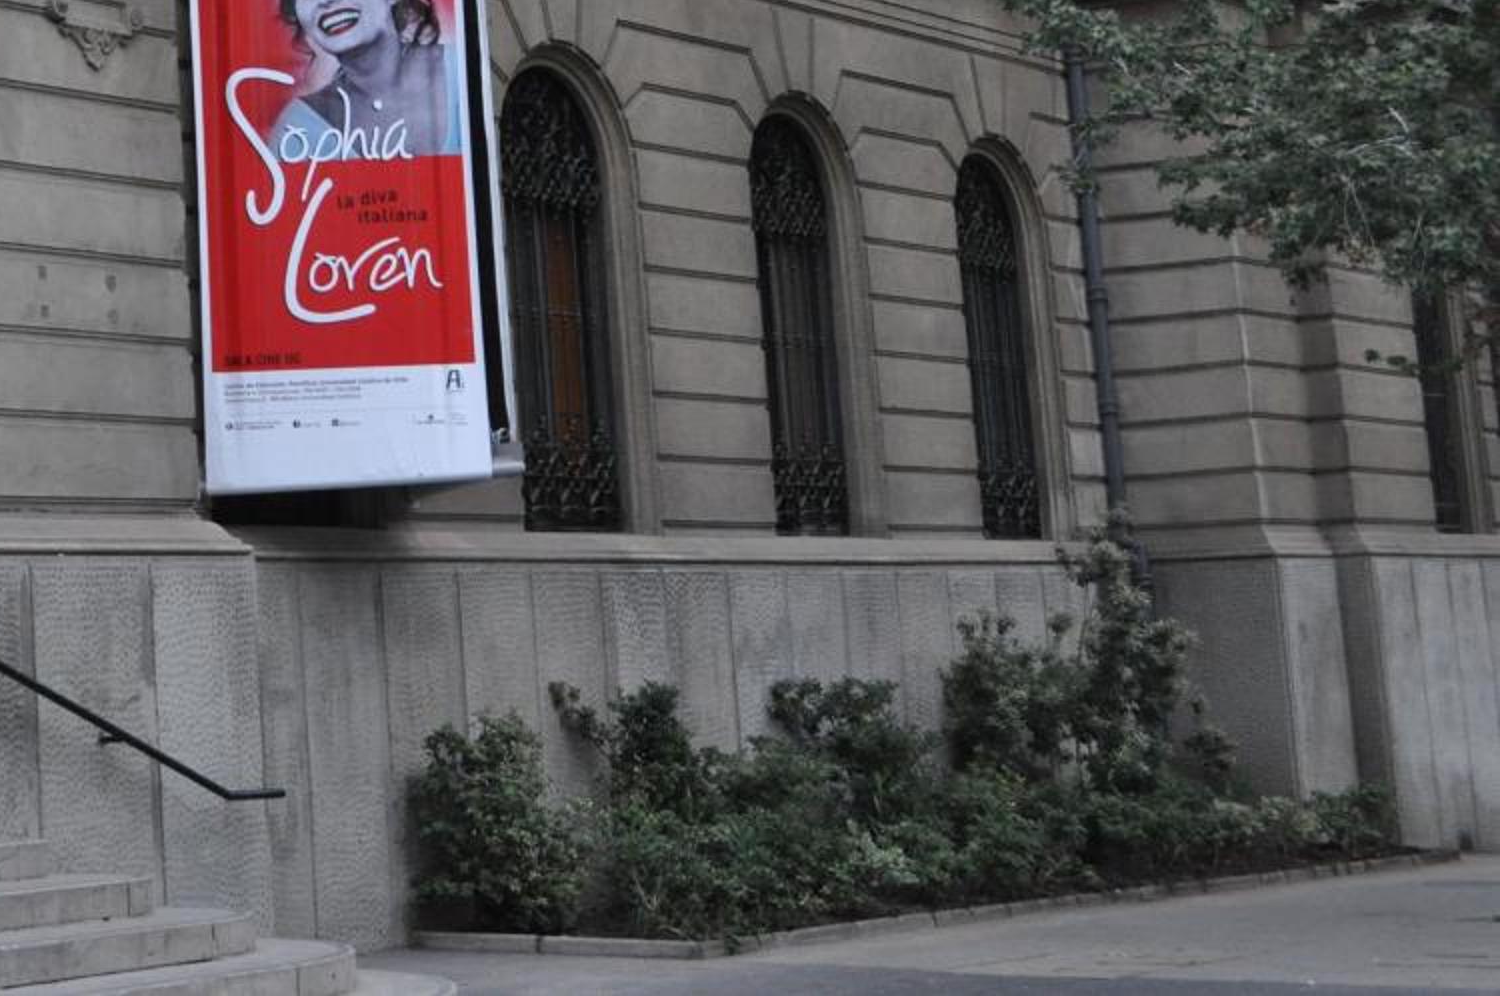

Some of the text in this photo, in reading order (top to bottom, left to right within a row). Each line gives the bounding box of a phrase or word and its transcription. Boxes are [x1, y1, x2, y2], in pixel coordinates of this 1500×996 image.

[226, 67, 413, 225] Sophia
[358, 207, 429, 225] italiana
[360, 188, 399, 205] diva
[284, 178, 444, 324] Loren
